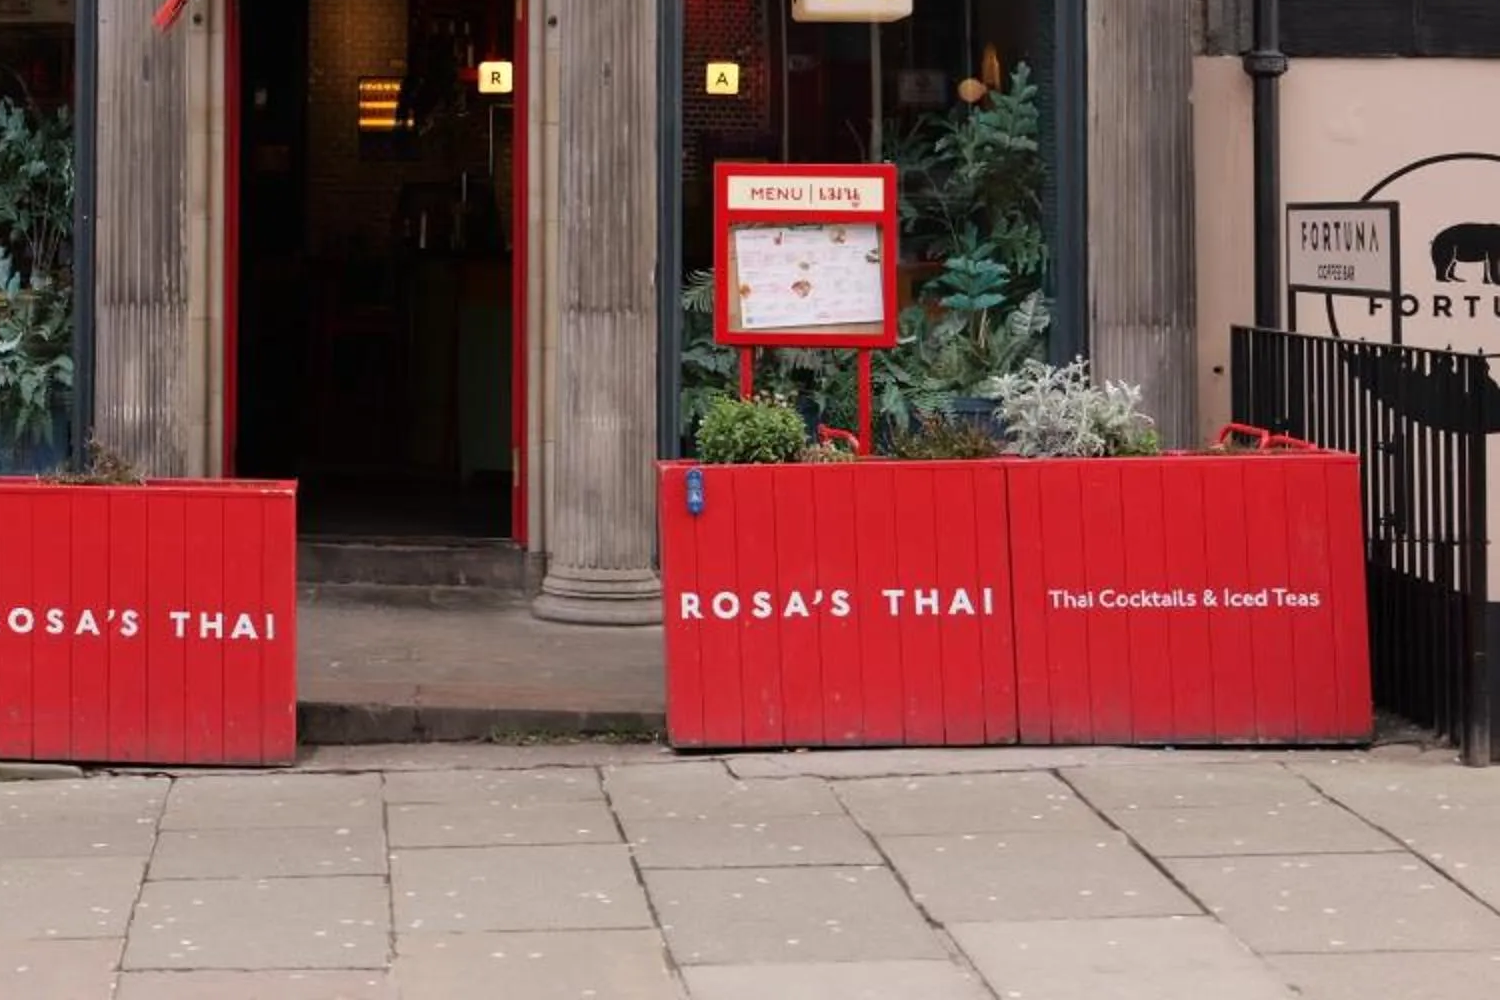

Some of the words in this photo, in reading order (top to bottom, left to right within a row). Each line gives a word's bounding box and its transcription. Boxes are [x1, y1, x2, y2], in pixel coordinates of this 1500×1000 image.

[490, 71, 502, 85] R
[715, 72, 729, 87] A
[750, 186, 803, 201] MENU
[1301, 221, 1379, 252] FORTUNA
[681, 590, 852, 620] ROSA'S
[883, 588, 994, 617] THAI
[1048, 590, 1095, 609] Thai
[1099, 589, 1198, 608] Cocktails
[1203, 589, 1218, 608] &
[1223, 588, 1268, 608] Iced
[1272, 588, 1321, 608] Teas
[170, 612, 275, 641] THAI
